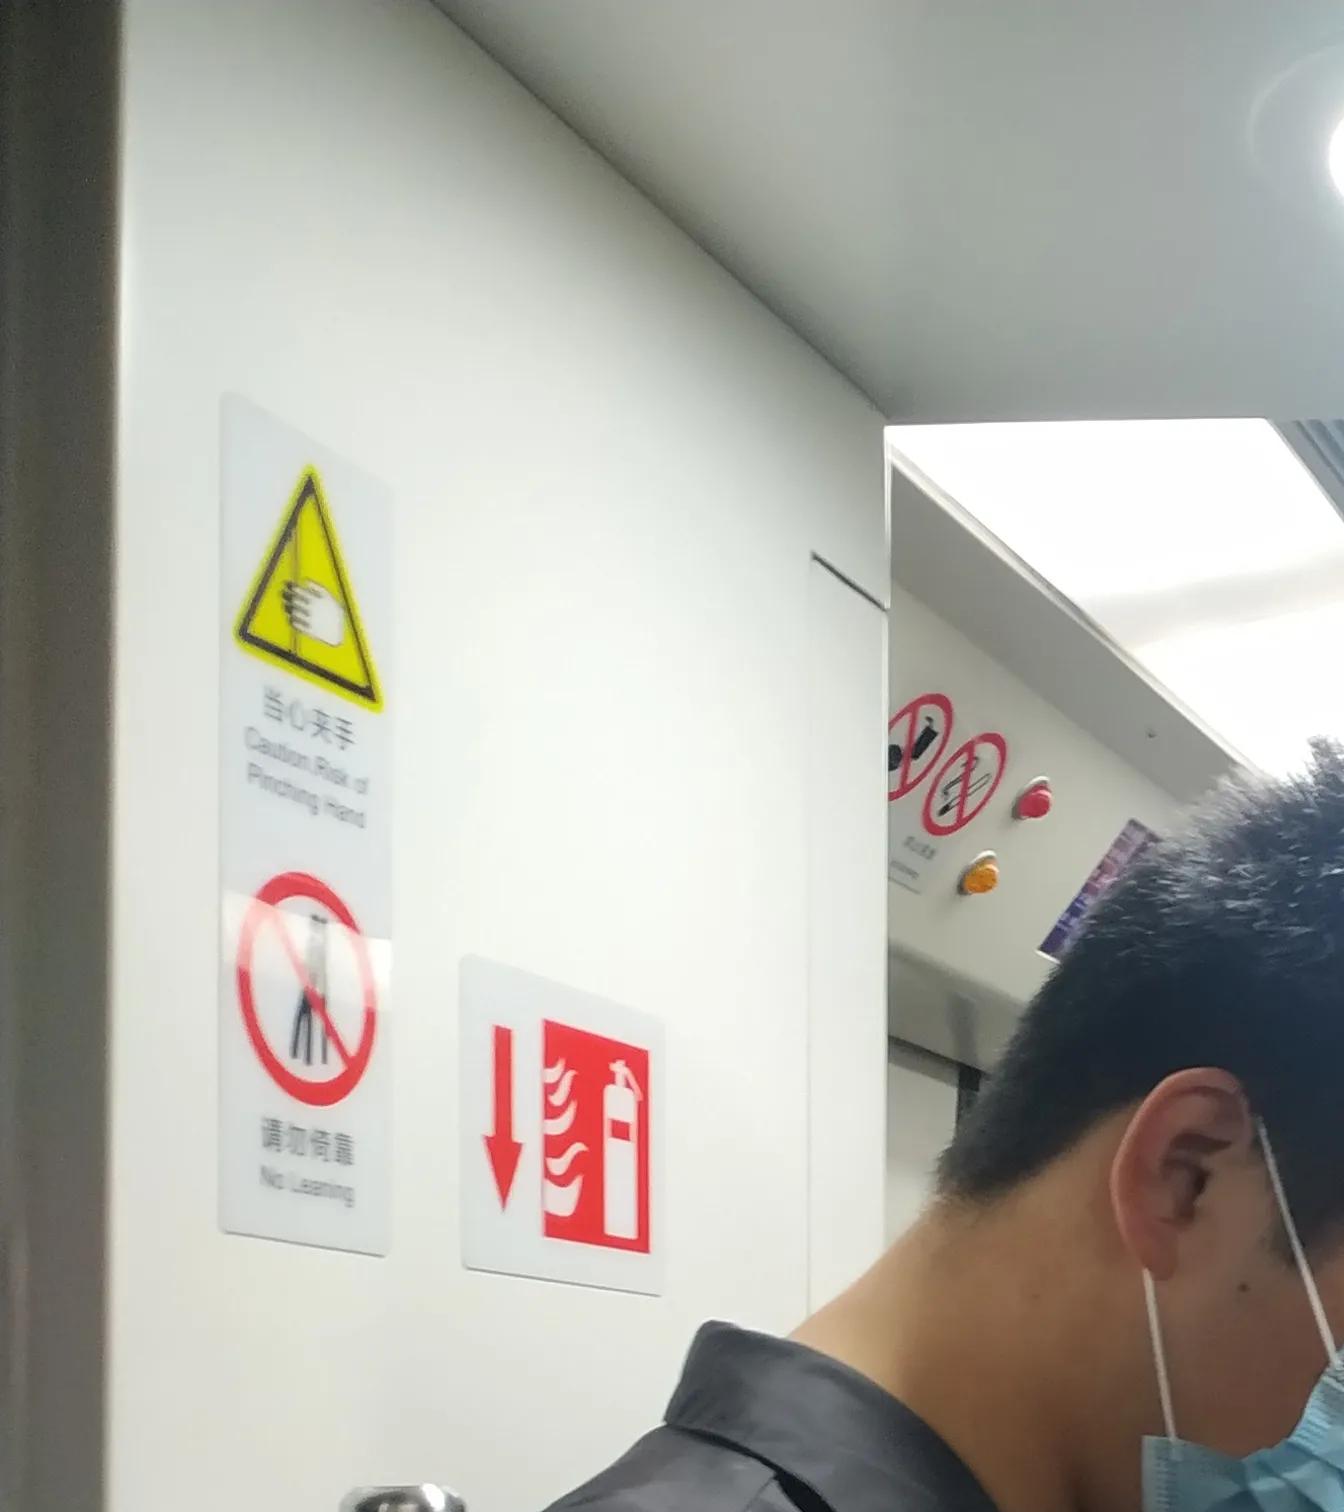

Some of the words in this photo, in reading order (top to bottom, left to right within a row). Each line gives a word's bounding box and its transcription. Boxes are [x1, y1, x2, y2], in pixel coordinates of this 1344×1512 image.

[263, 685, 355, 750] 当心夹手
[248, 761, 320, 816] Pinching
[261, 1115, 356, 1166] 请勿倚靠
